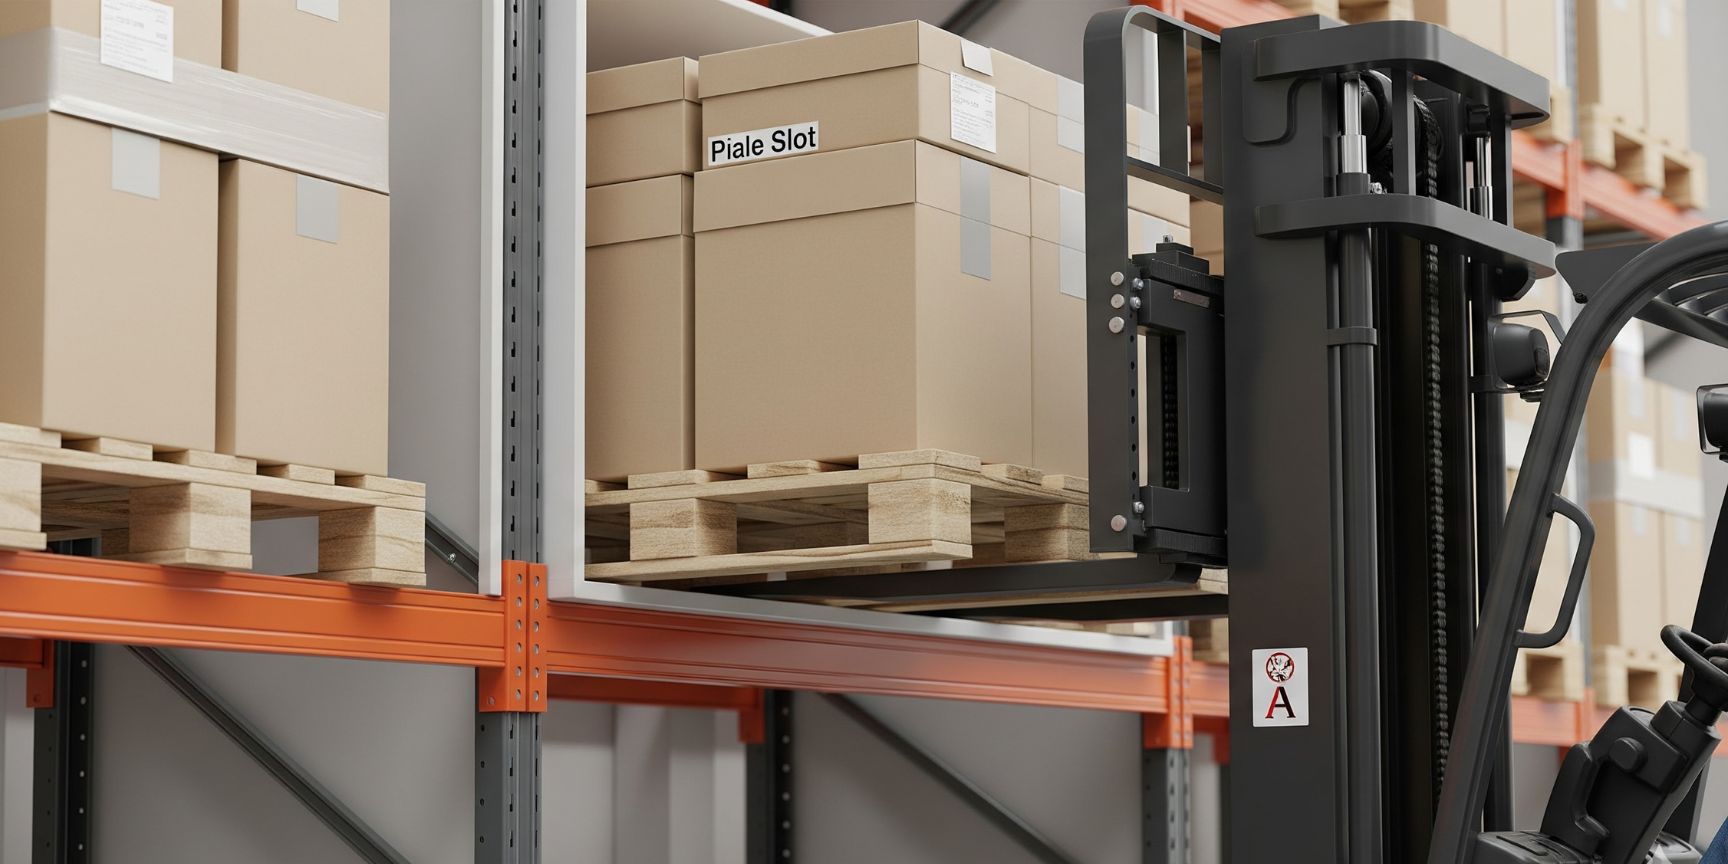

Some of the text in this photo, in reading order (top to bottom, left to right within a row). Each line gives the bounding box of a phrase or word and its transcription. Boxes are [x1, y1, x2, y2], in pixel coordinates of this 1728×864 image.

[711, 126, 816, 163] Piale Slot
[1265, 686, 1296, 719] A
